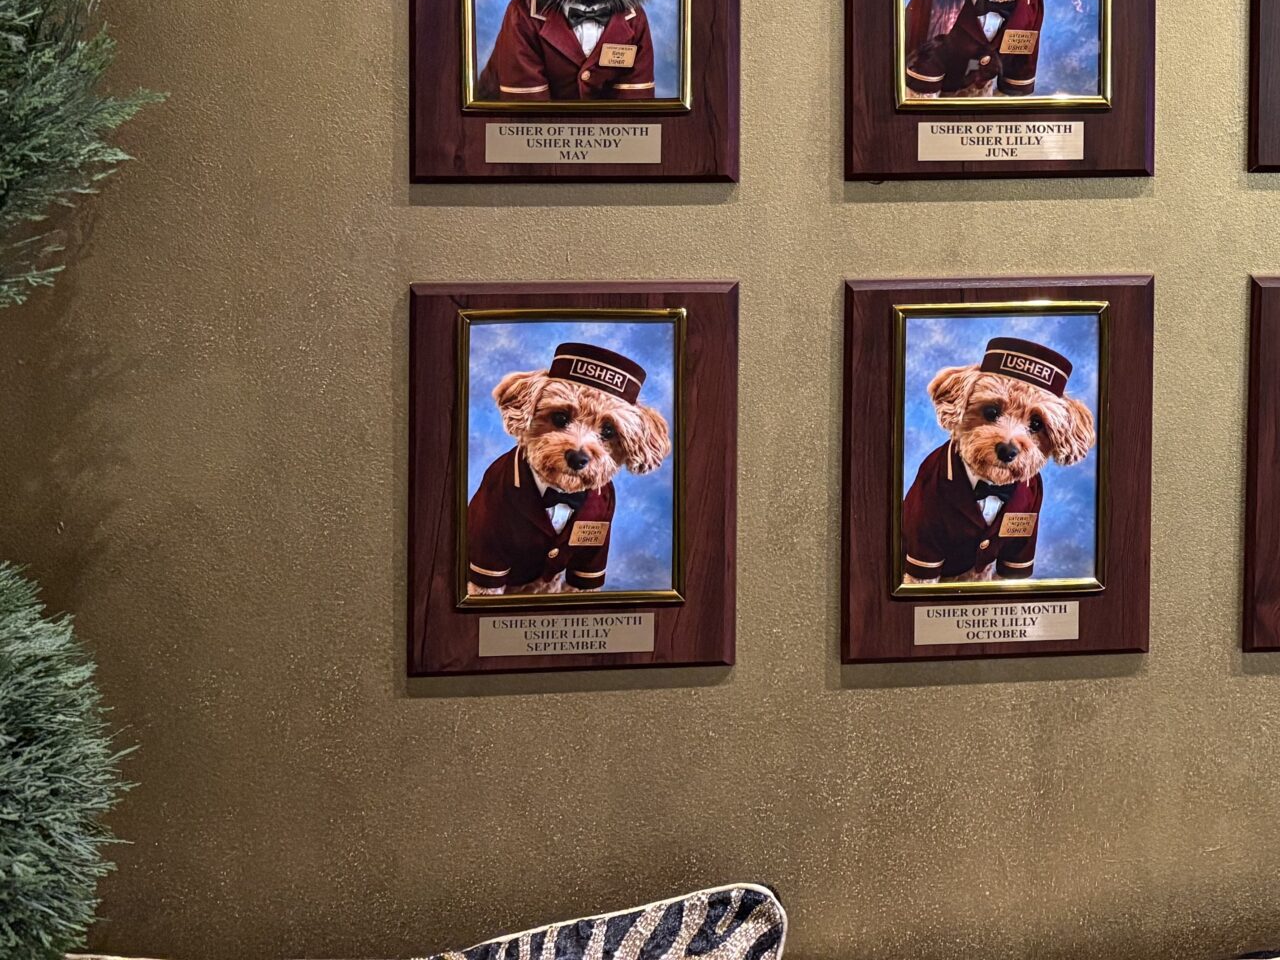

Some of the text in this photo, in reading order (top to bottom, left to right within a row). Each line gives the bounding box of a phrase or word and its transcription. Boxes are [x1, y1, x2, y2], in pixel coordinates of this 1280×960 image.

[498, 126, 648, 136] USHER OF THE MONTH
[930, 124, 1072, 134] USHER OF THE MONTH
[526, 138, 621, 148] USHER RANDY
[960, 136, 1042, 145] USHER LILLY
[559, 150, 588, 160] MAY
[985, 147, 1017, 156] JUNE
[1006, 356, 1052, 381] USHER
[577, 362, 624, 387] USHER
[926, 604, 1066, 618] USHER OF THE MONTH
[492, 616, 641, 628] USHER OF THE MONTH
[956, 616, 1037, 628] USHER LILLY
[524, 628, 610, 640] USHER LILLY
[966, 629, 1026, 640] OCTOBER
[526, 640, 606, 651] SEPTEMBER
